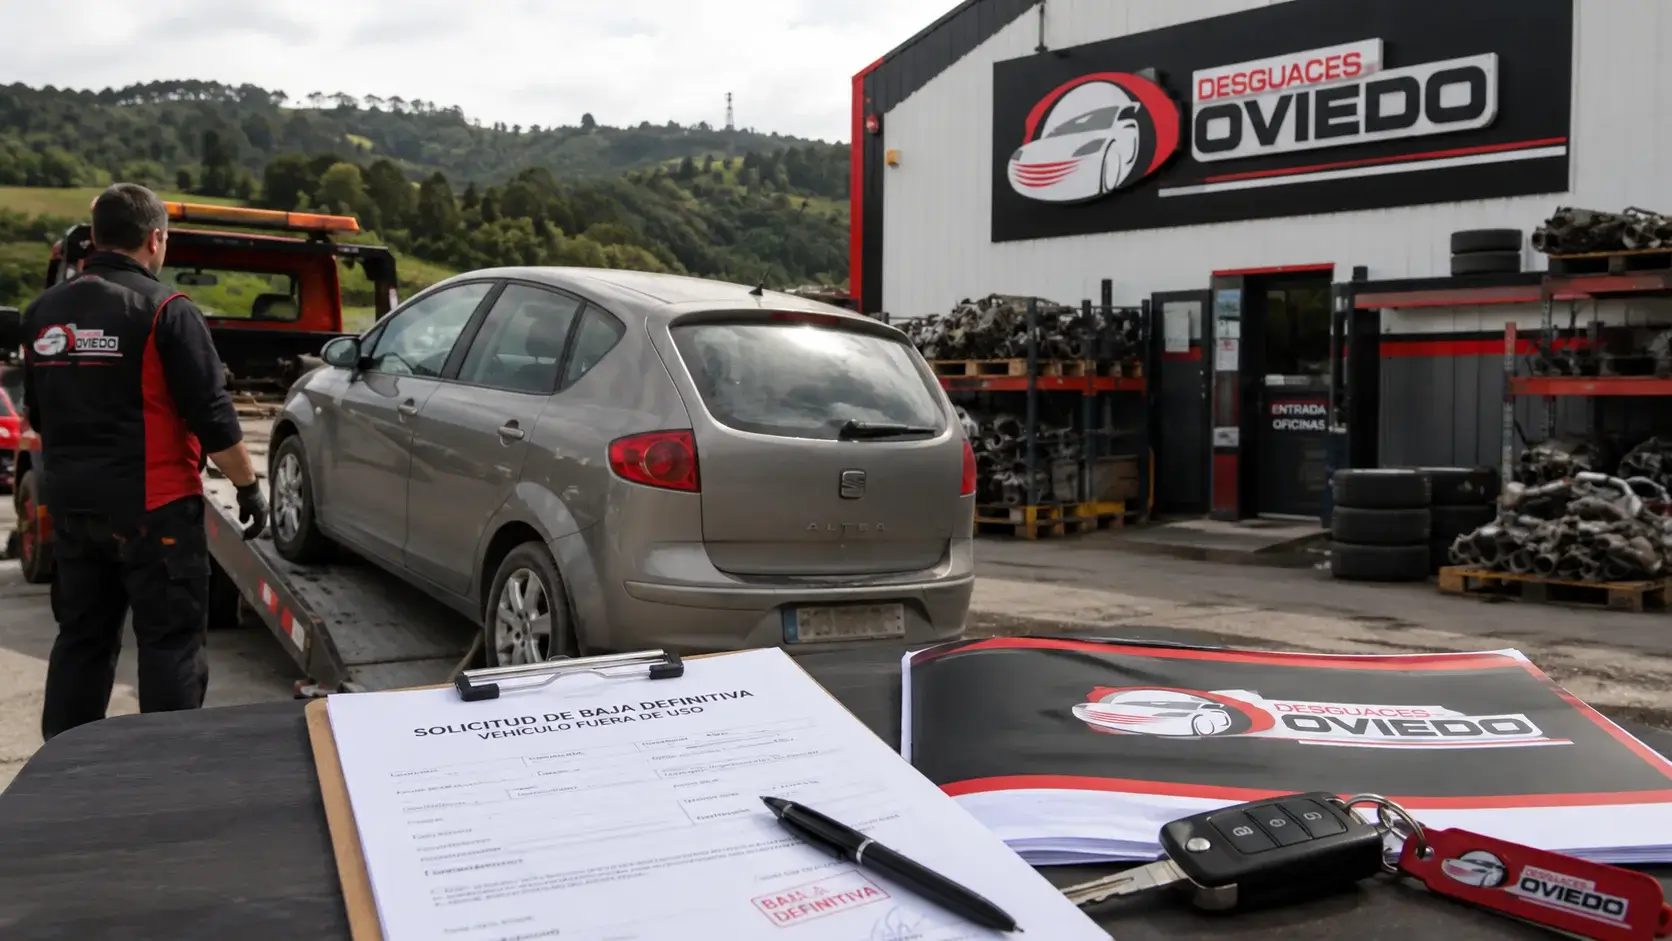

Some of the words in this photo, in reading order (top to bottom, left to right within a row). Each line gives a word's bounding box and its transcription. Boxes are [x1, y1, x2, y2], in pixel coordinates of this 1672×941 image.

[1198, 51, 1363, 101] DESGUACES
[1193, 65, 1488, 154] OVIEDO
[75, 338, 116, 348] OVIEDO
[1271, 404, 1326, 415] ENTRADA
[1272, 419, 1326, 430] OFICINAS
[806, 521, 886, 532] ALTEA
[413, 715, 537, 737] SOLICITUD
[543, 711, 574, 723] DE
[578, 704, 636, 718] BAJA
[639, 689, 754, 711] DEFINITIVA
[576, 715, 636, 729] FUERA
[639, 711, 665, 721] DE
[667, 706, 704, 717] USO
[1273, 703, 1431, 718] DESGUACES
[1280, 713, 1534, 737] OVIEDO
[773, 886, 880, 922] DEFINITIVA
[1520, 877, 1625, 916] OVIEDO
